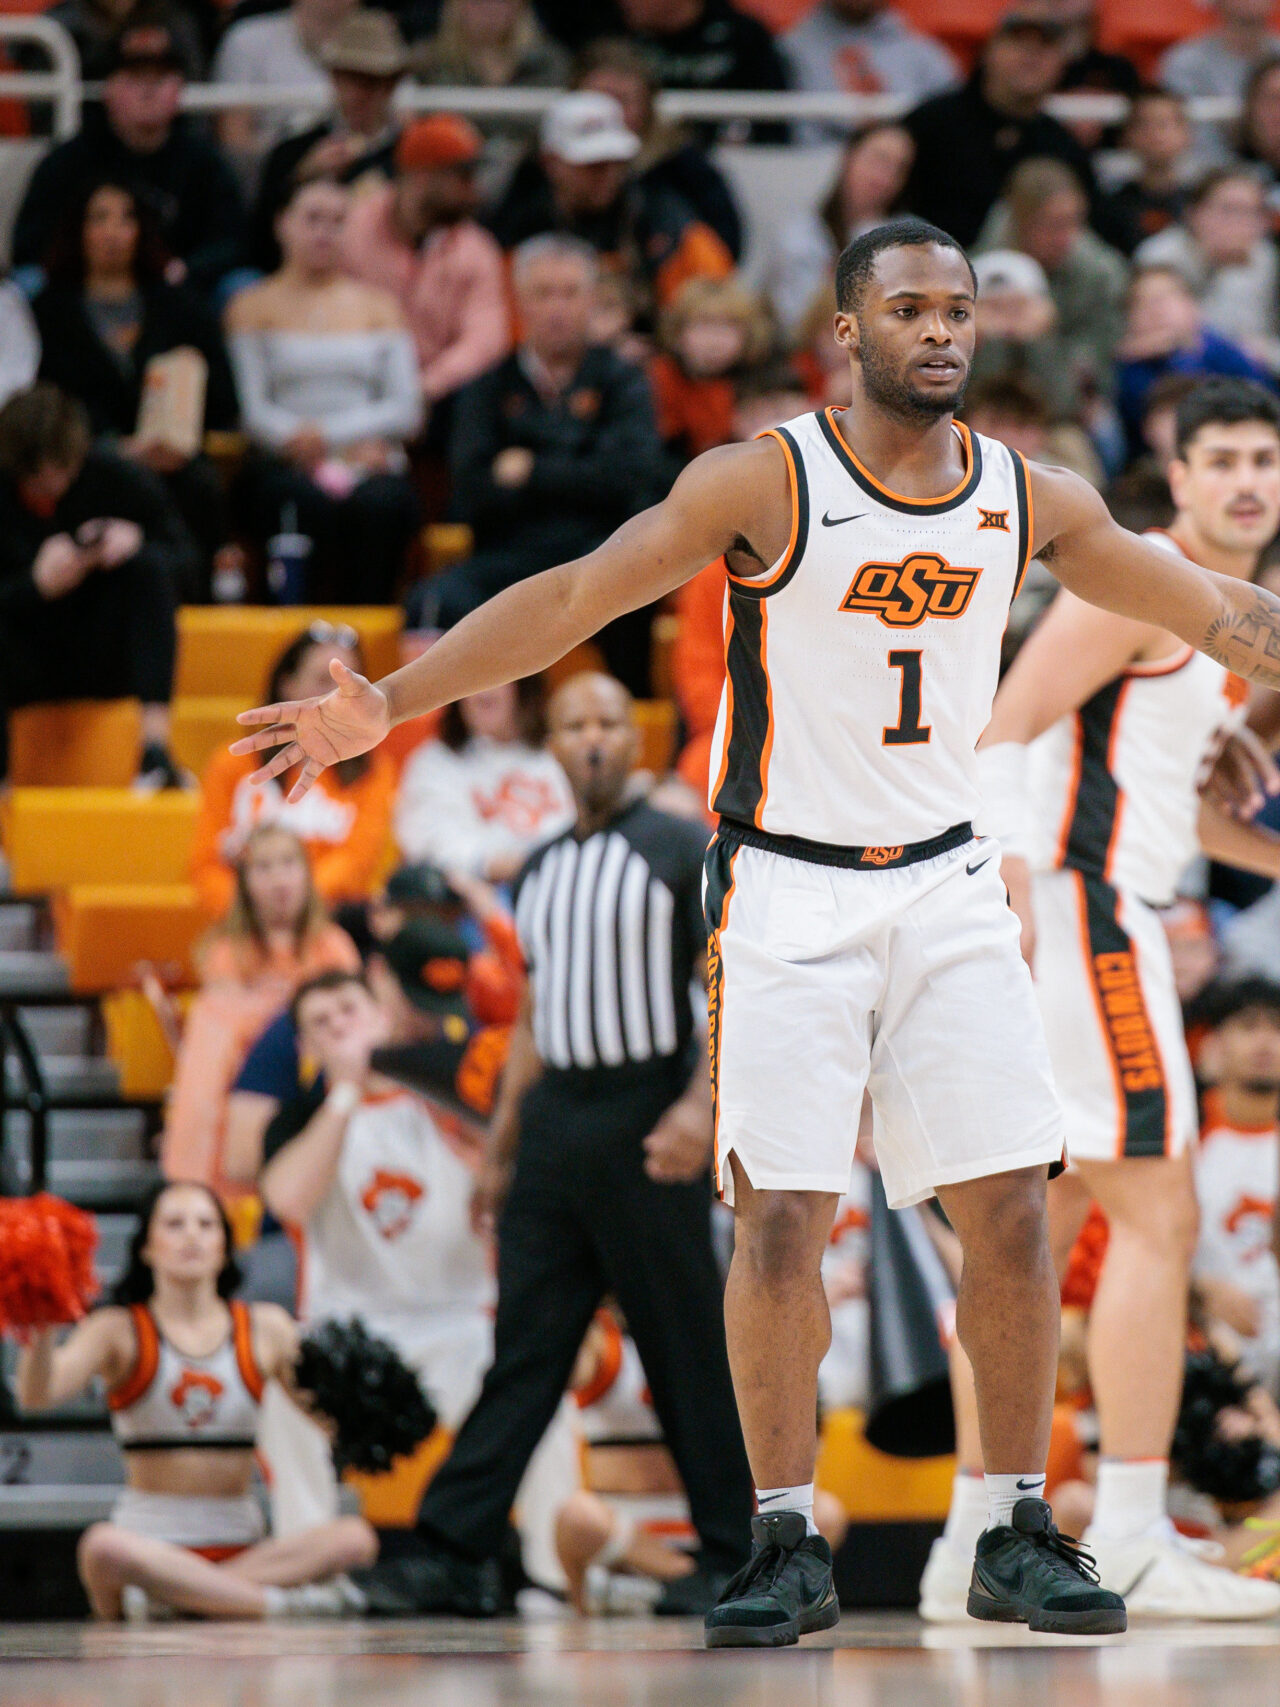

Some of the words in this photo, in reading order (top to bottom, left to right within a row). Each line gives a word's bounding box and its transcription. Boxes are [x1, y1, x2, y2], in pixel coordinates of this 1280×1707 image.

[979, 508, 1010, 532] XII
[838, 552, 984, 629] OSU
[882, 649, 931, 746] 1
[861, 844, 904, 866] OSU
[1094, 951, 1161, 1091] COWBOYS
